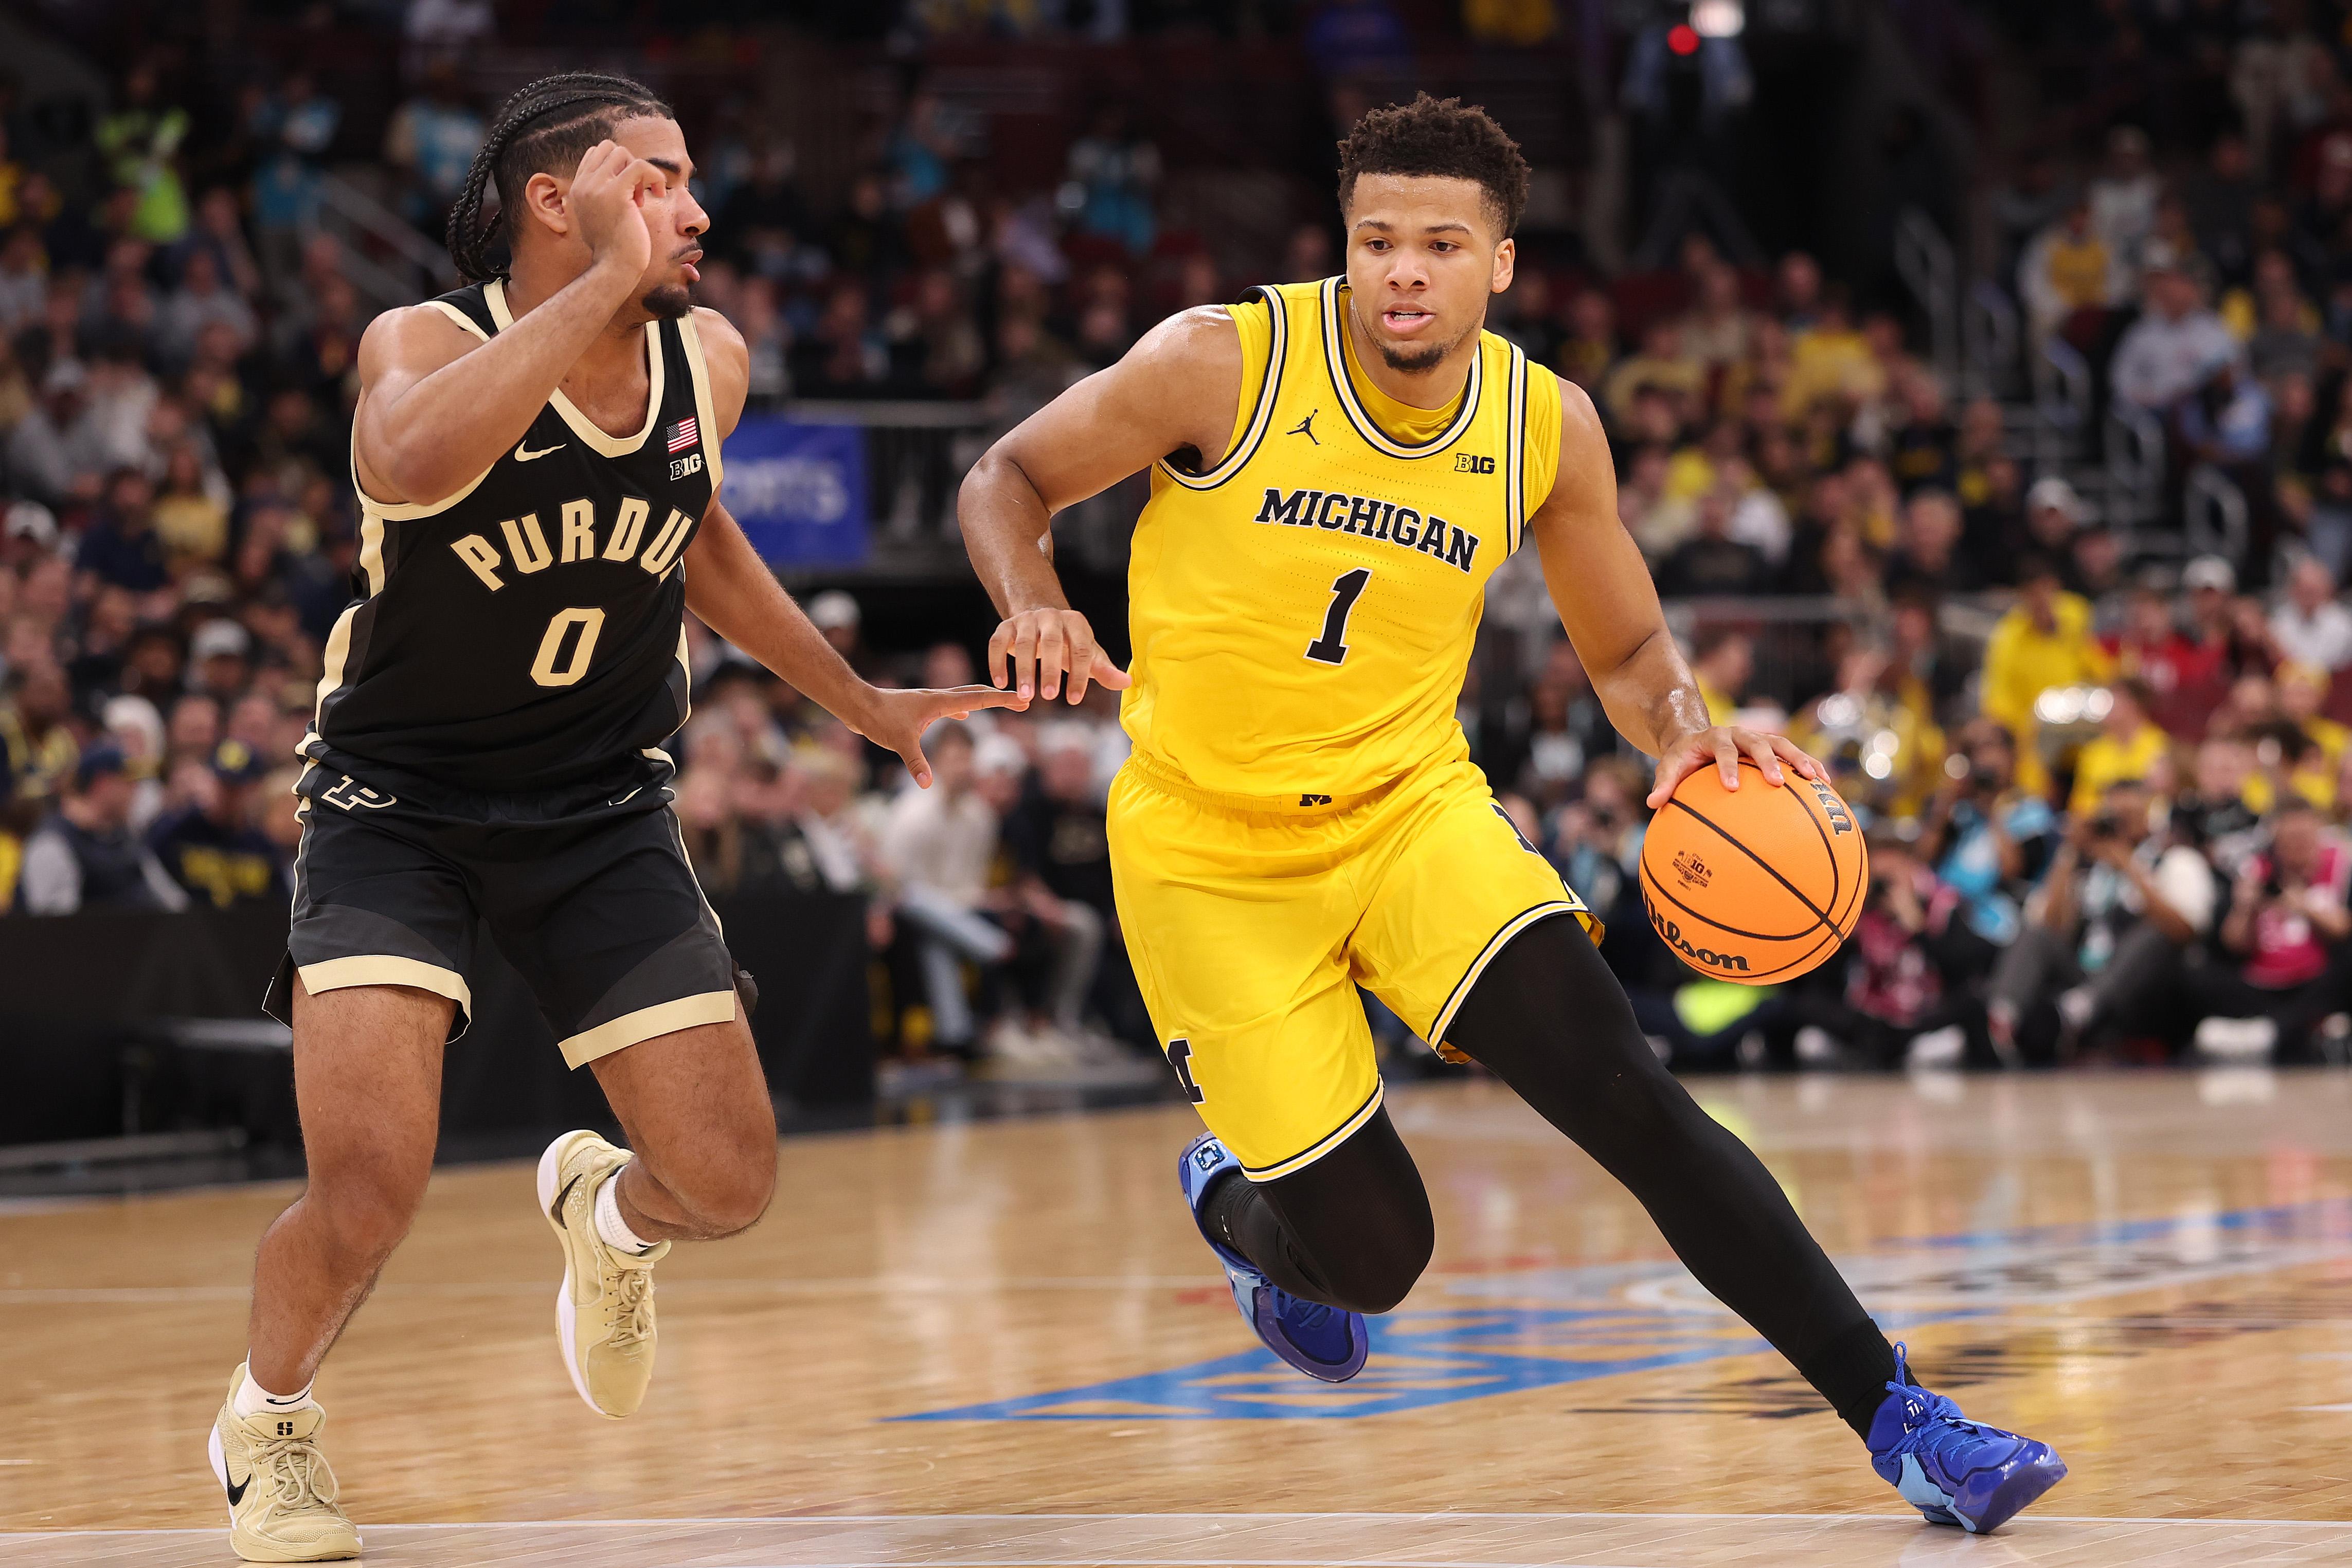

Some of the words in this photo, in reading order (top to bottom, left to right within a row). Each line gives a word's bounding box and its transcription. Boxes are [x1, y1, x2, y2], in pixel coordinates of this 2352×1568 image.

[450, 494, 695, 594] PURDU
[1252, 487, 1481, 575] MICHIGAN
[528, 605, 606, 689] 0
[1303, 566, 1374, 666] 1
